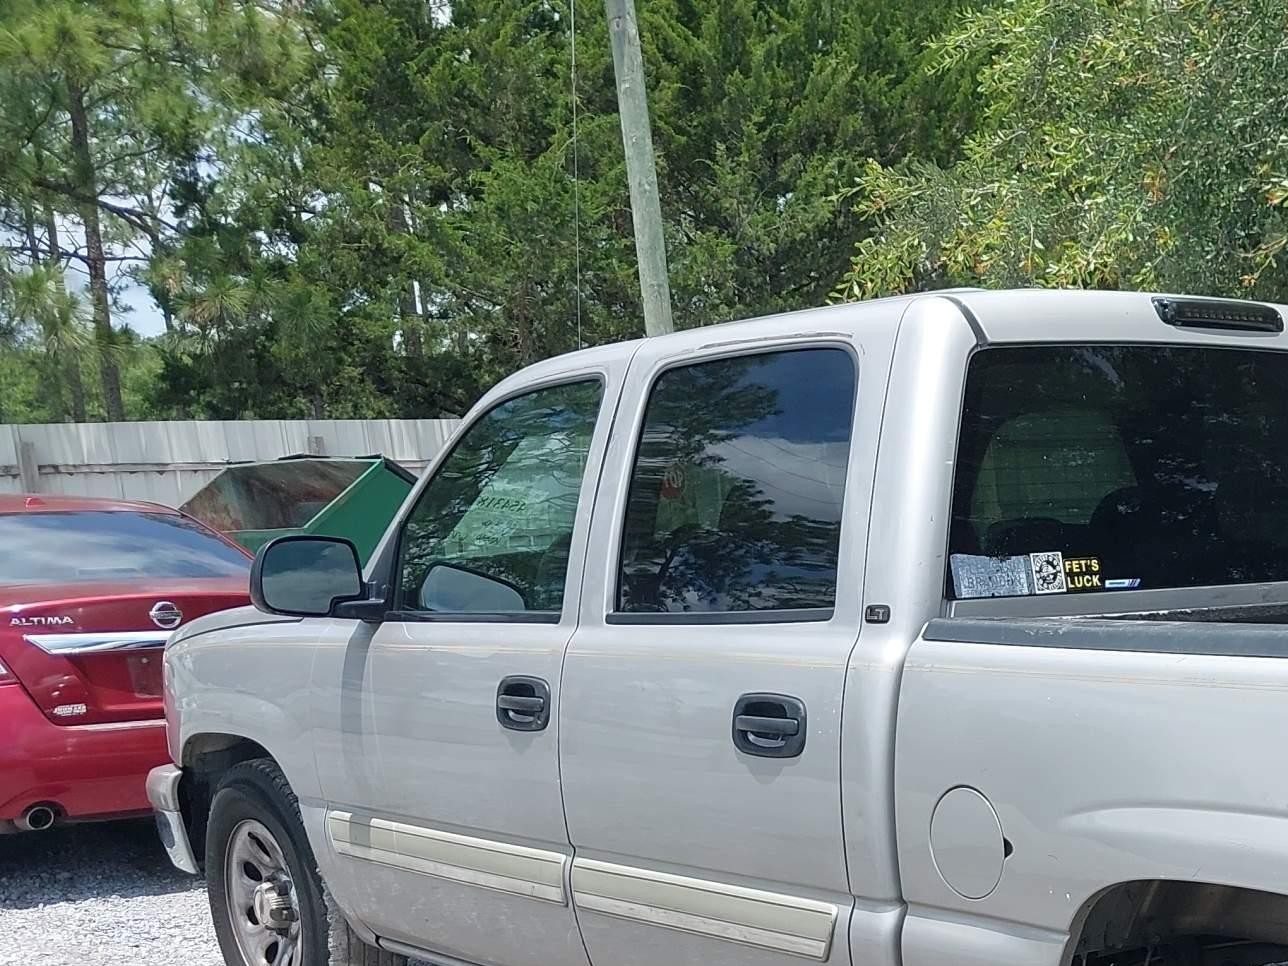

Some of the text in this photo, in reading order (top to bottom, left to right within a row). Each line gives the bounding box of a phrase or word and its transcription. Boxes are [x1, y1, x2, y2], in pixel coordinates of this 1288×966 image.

[1064, 559, 1100, 573] FET'S
[1067, 574, 1102, 589] LUCK
[9, 615, 75, 627] ALTIMA
